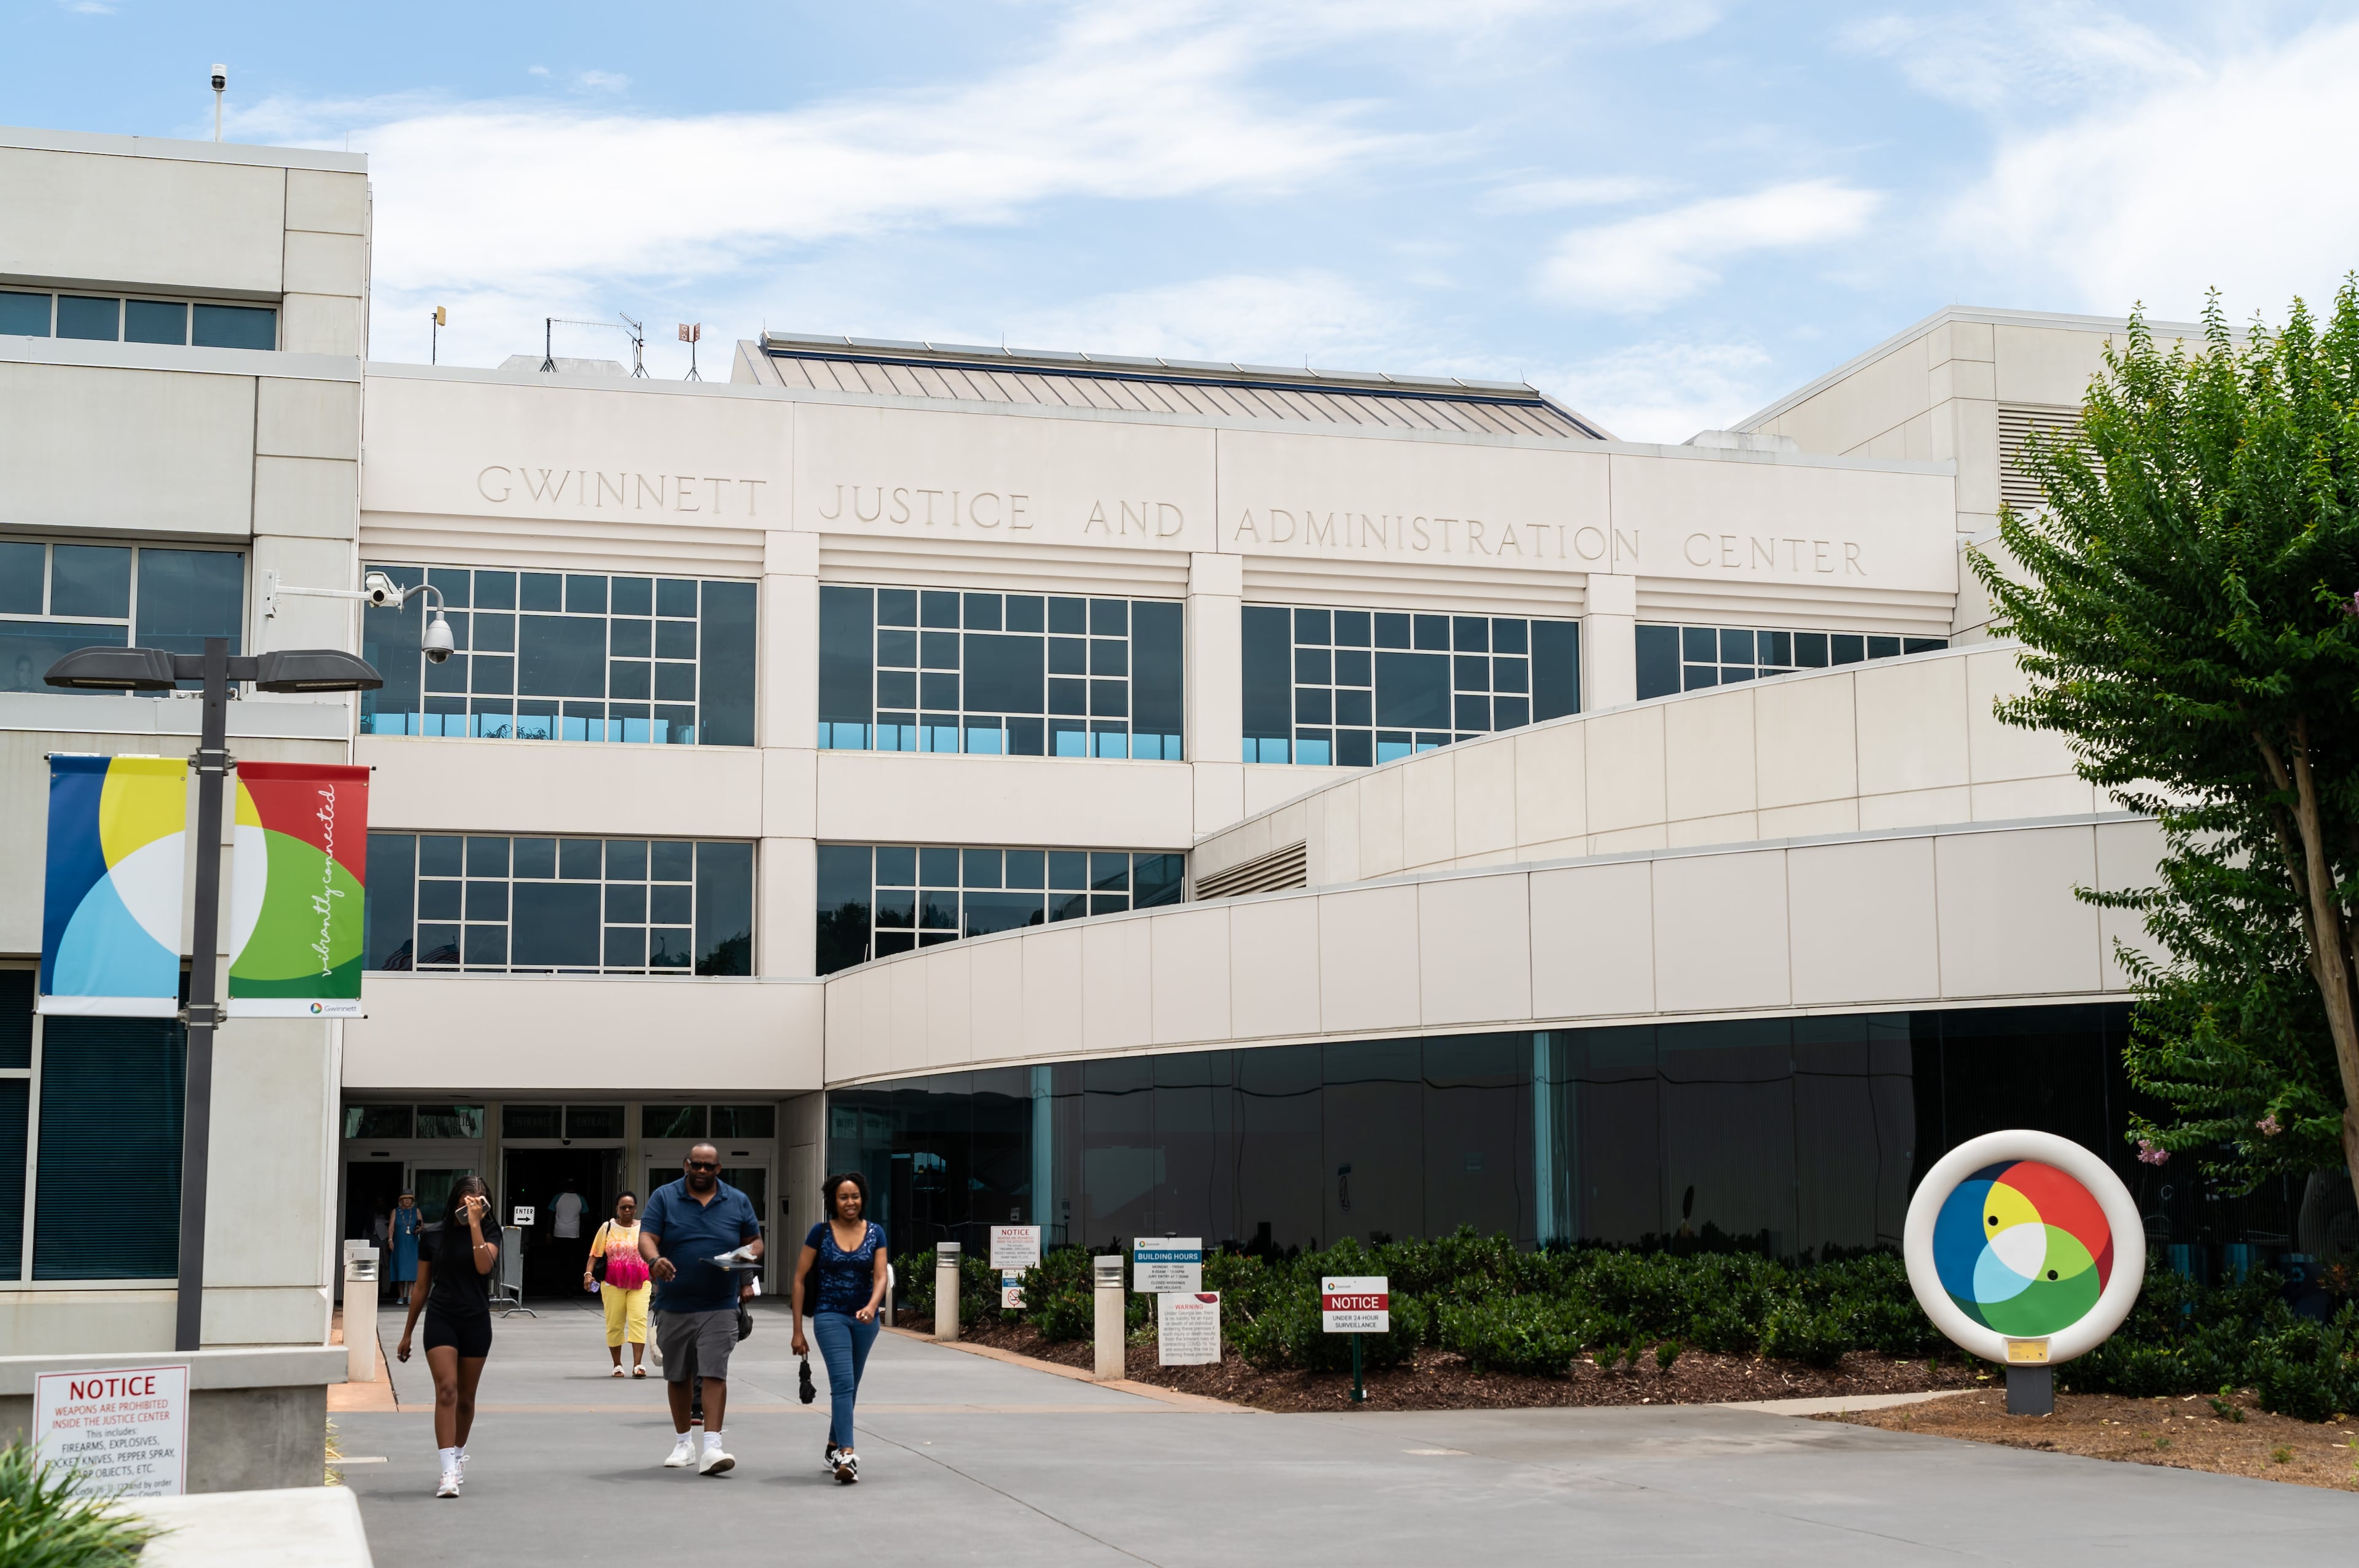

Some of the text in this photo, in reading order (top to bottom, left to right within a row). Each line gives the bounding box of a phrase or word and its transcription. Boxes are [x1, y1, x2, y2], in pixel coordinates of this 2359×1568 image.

[476, 465, 1869, 575] GWINNETT JUSTICE AND ADMINISTRATION CENTER
[311, 784, 345, 977] vibrantly connected
[1332, 1297, 1379, 1309] NOTICE
[70, 1376, 155, 1400] NOTICE
[55, 1400, 168, 1416] WEAPONS ARE PROHIBITED
[52, 1411, 170, 1429] INSIDE THE JUSTICE CENTER
[86, 1427, 138, 1438] This includes:
[62, 1436, 160, 1453] FIREARMS, EXPLOSIVES,
[82, 1454, 114, 1465] KNIVES,
[117, 1451, 146, 1462] PEPPER
[149, 1448, 176, 1459] SPRAY,
[95, 1467, 134, 1478] OBJECTS,
[137, 1464, 155, 1474] ETC.
[144, 1481, 152, 1489] by
